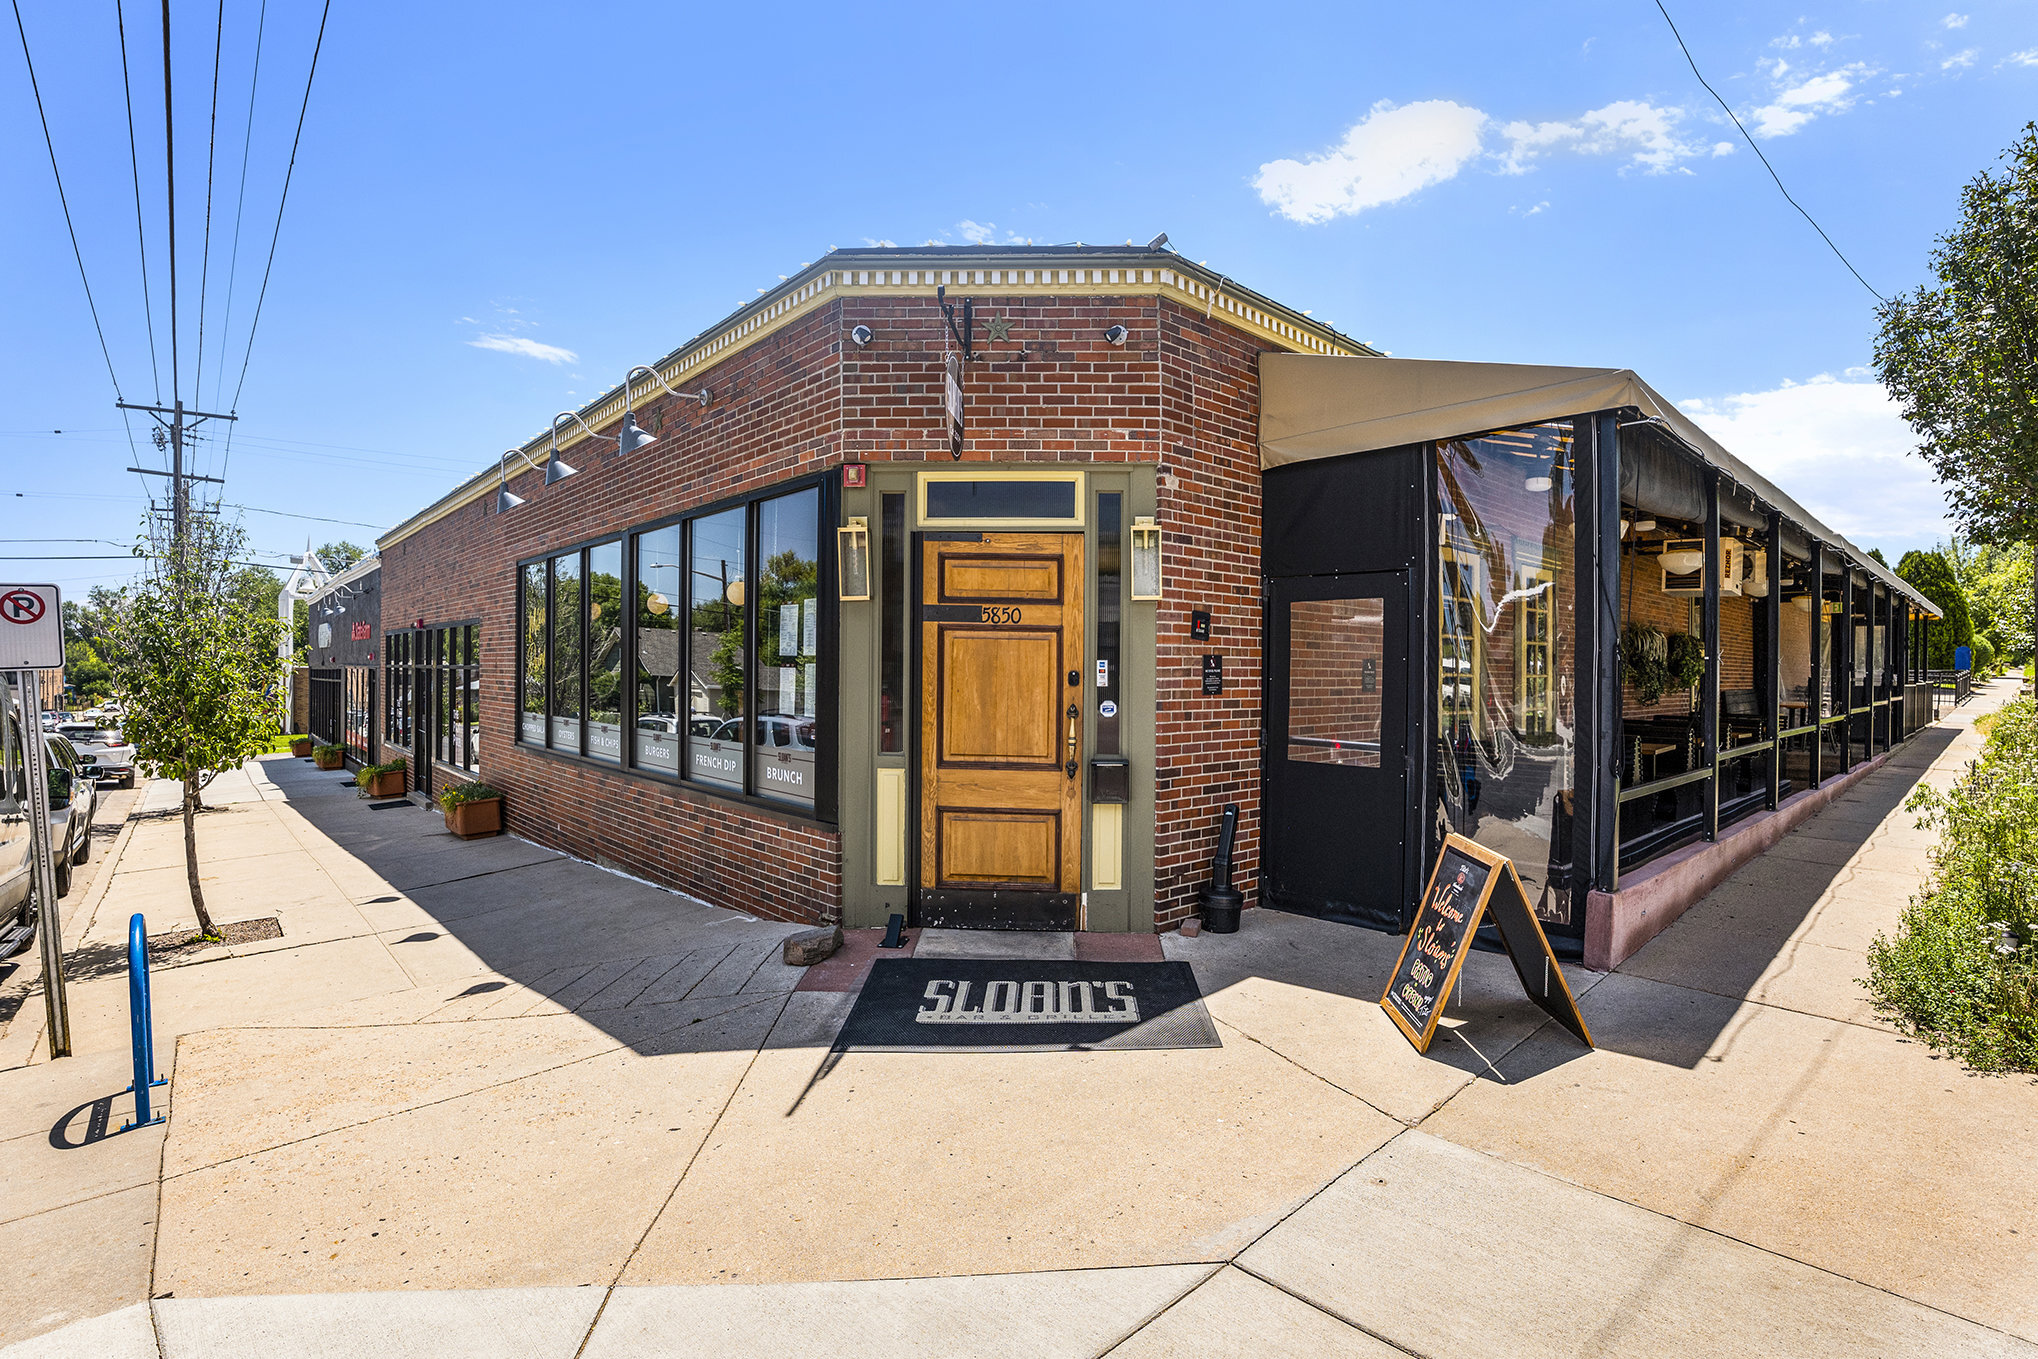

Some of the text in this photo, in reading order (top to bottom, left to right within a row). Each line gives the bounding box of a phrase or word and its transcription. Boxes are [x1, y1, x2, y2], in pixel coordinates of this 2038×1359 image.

[982, 606, 1021, 624] 5850
[558, 729, 575, 740] OYSTERS
[590, 735, 600, 745] FISH
[605, 738, 619, 749] CHIPS
[645, 745, 670, 759] BURGERS
[695, 754, 737, 772] FRENCH DIP
[766, 766, 803, 785] BRUNCH
[1431, 883, 1464, 924] Welcome
